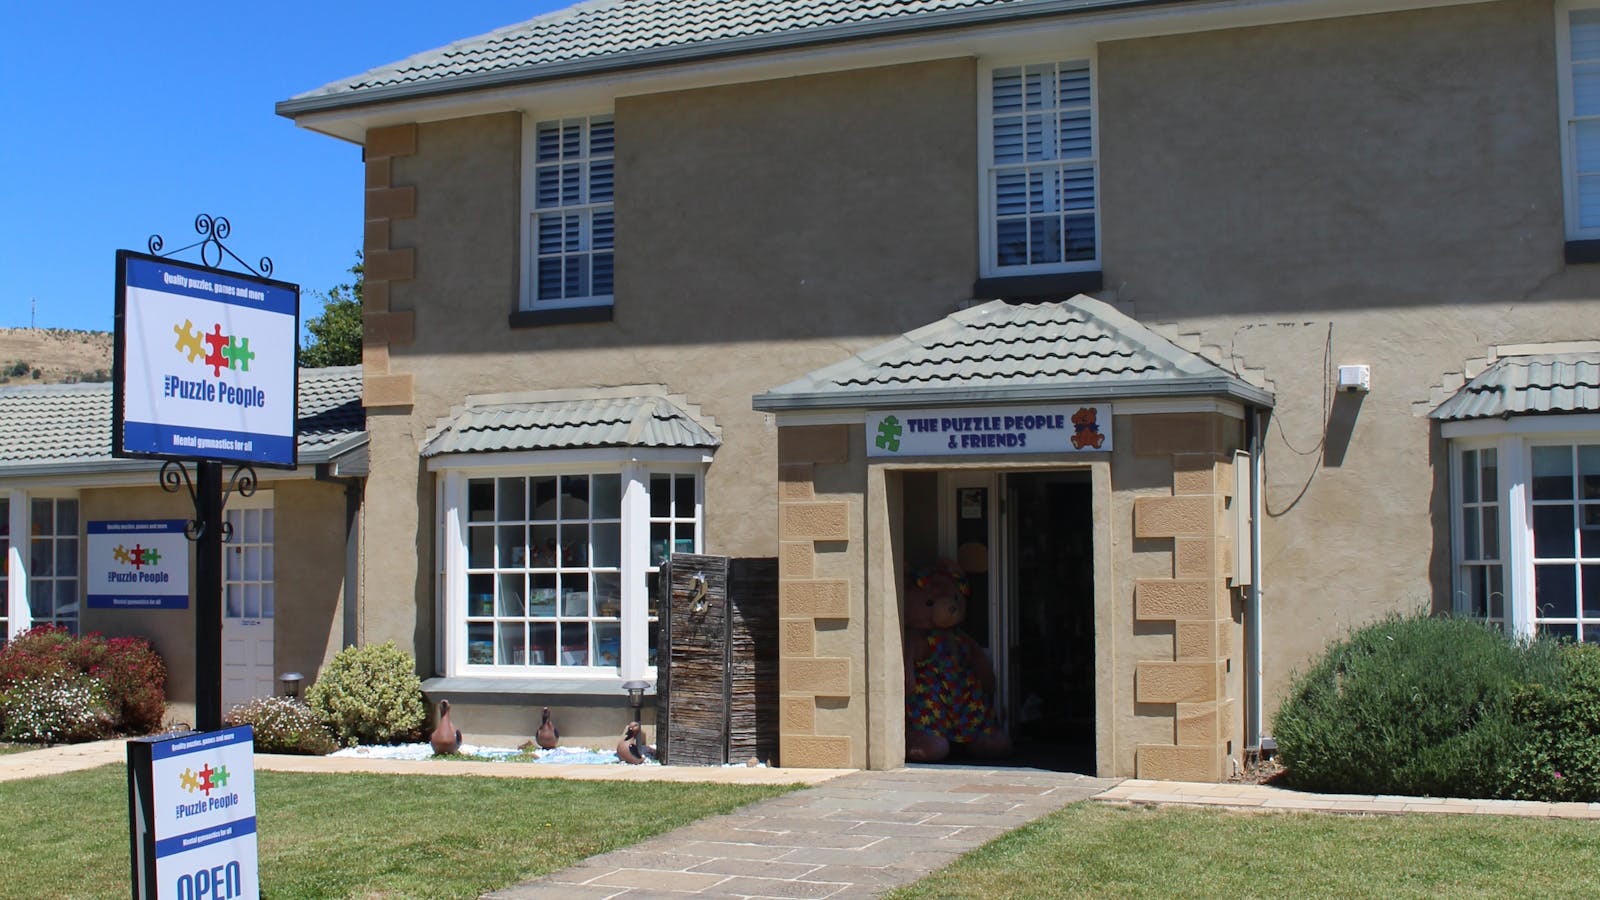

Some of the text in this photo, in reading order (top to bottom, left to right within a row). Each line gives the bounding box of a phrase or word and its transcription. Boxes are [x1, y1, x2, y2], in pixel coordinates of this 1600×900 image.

[164, 272, 265, 302] Quality puzzles, games and more
[171, 375, 215, 402] Puzzle
[219, 381, 265, 408] People
[907, 414, 1065, 433] THE PUZZLE PEOPLE
[173, 434, 253, 452] Mental gymnastics for all
[948, 433, 1027, 449] & FRIENDS
[112, 571, 137, 583] Puzzle
[139, 571, 169, 584] People
[689, 571, 708, 615] 2
[180, 800, 207, 818] Puzzle
[209, 793, 239, 811] People
[177, 860, 242, 900] OPEN
